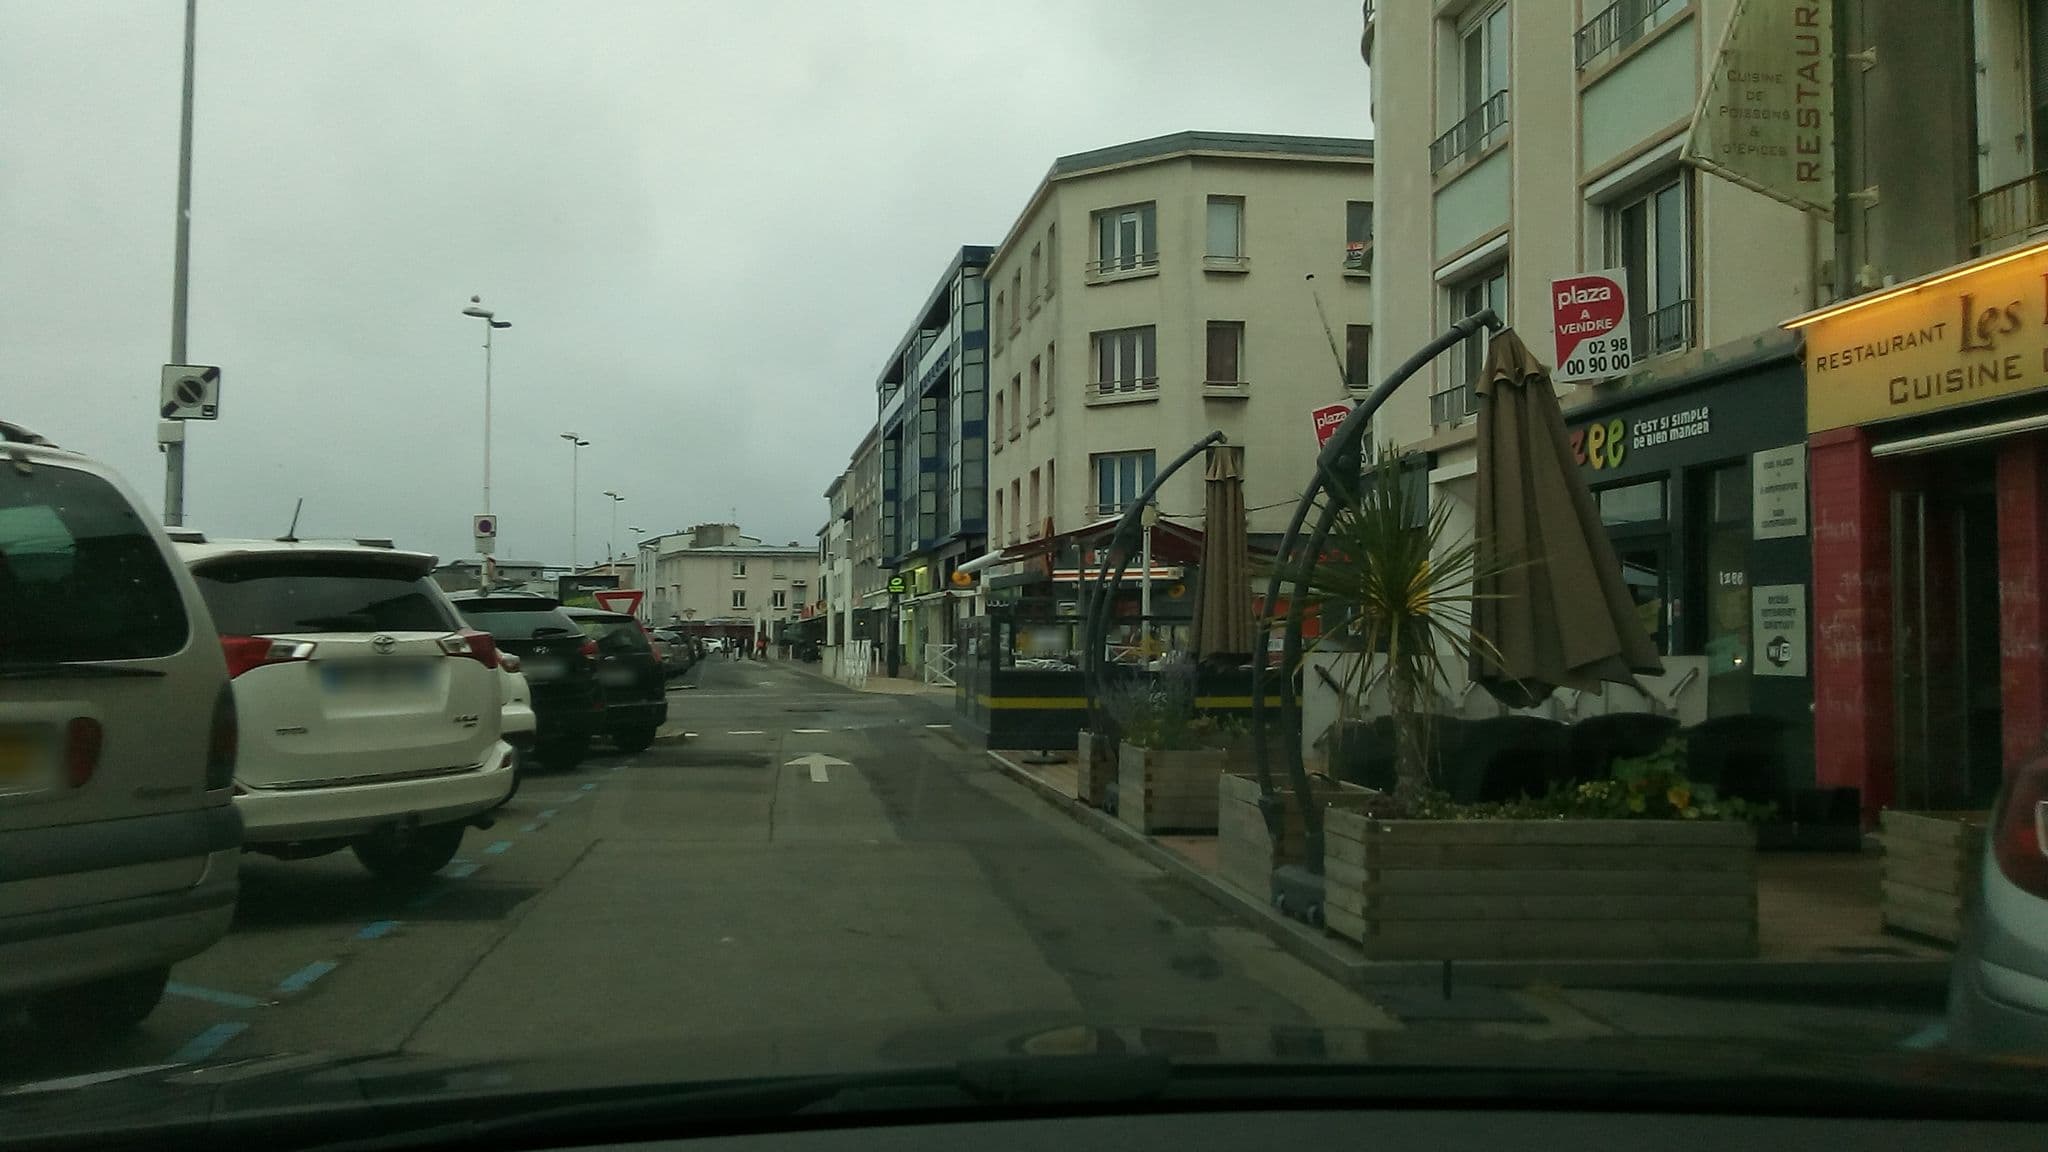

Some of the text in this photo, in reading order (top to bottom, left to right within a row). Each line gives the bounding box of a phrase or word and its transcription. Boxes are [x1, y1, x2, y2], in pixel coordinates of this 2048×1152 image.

[1727, 69, 1784, 84] CUISINE
[1745, 90, 1765, 101] DE
[1796, 0, 1821, 182] RESTAUR
[1718, 105, 1791, 121] POISSONS
[1557, 285, 1611, 311] plaza
[1580, 309, 1591, 320] A
[1559, 318, 1613, 335] VENDRE
[1816, 322, 1947, 373] RESTAURANT
[1959, 292, 2022, 353] Les
[1588, 337, 1628, 355] 02 98
[1566, 353, 1630, 376] 00 90 00
[1888, 354, 2023, 405] CUISINE
